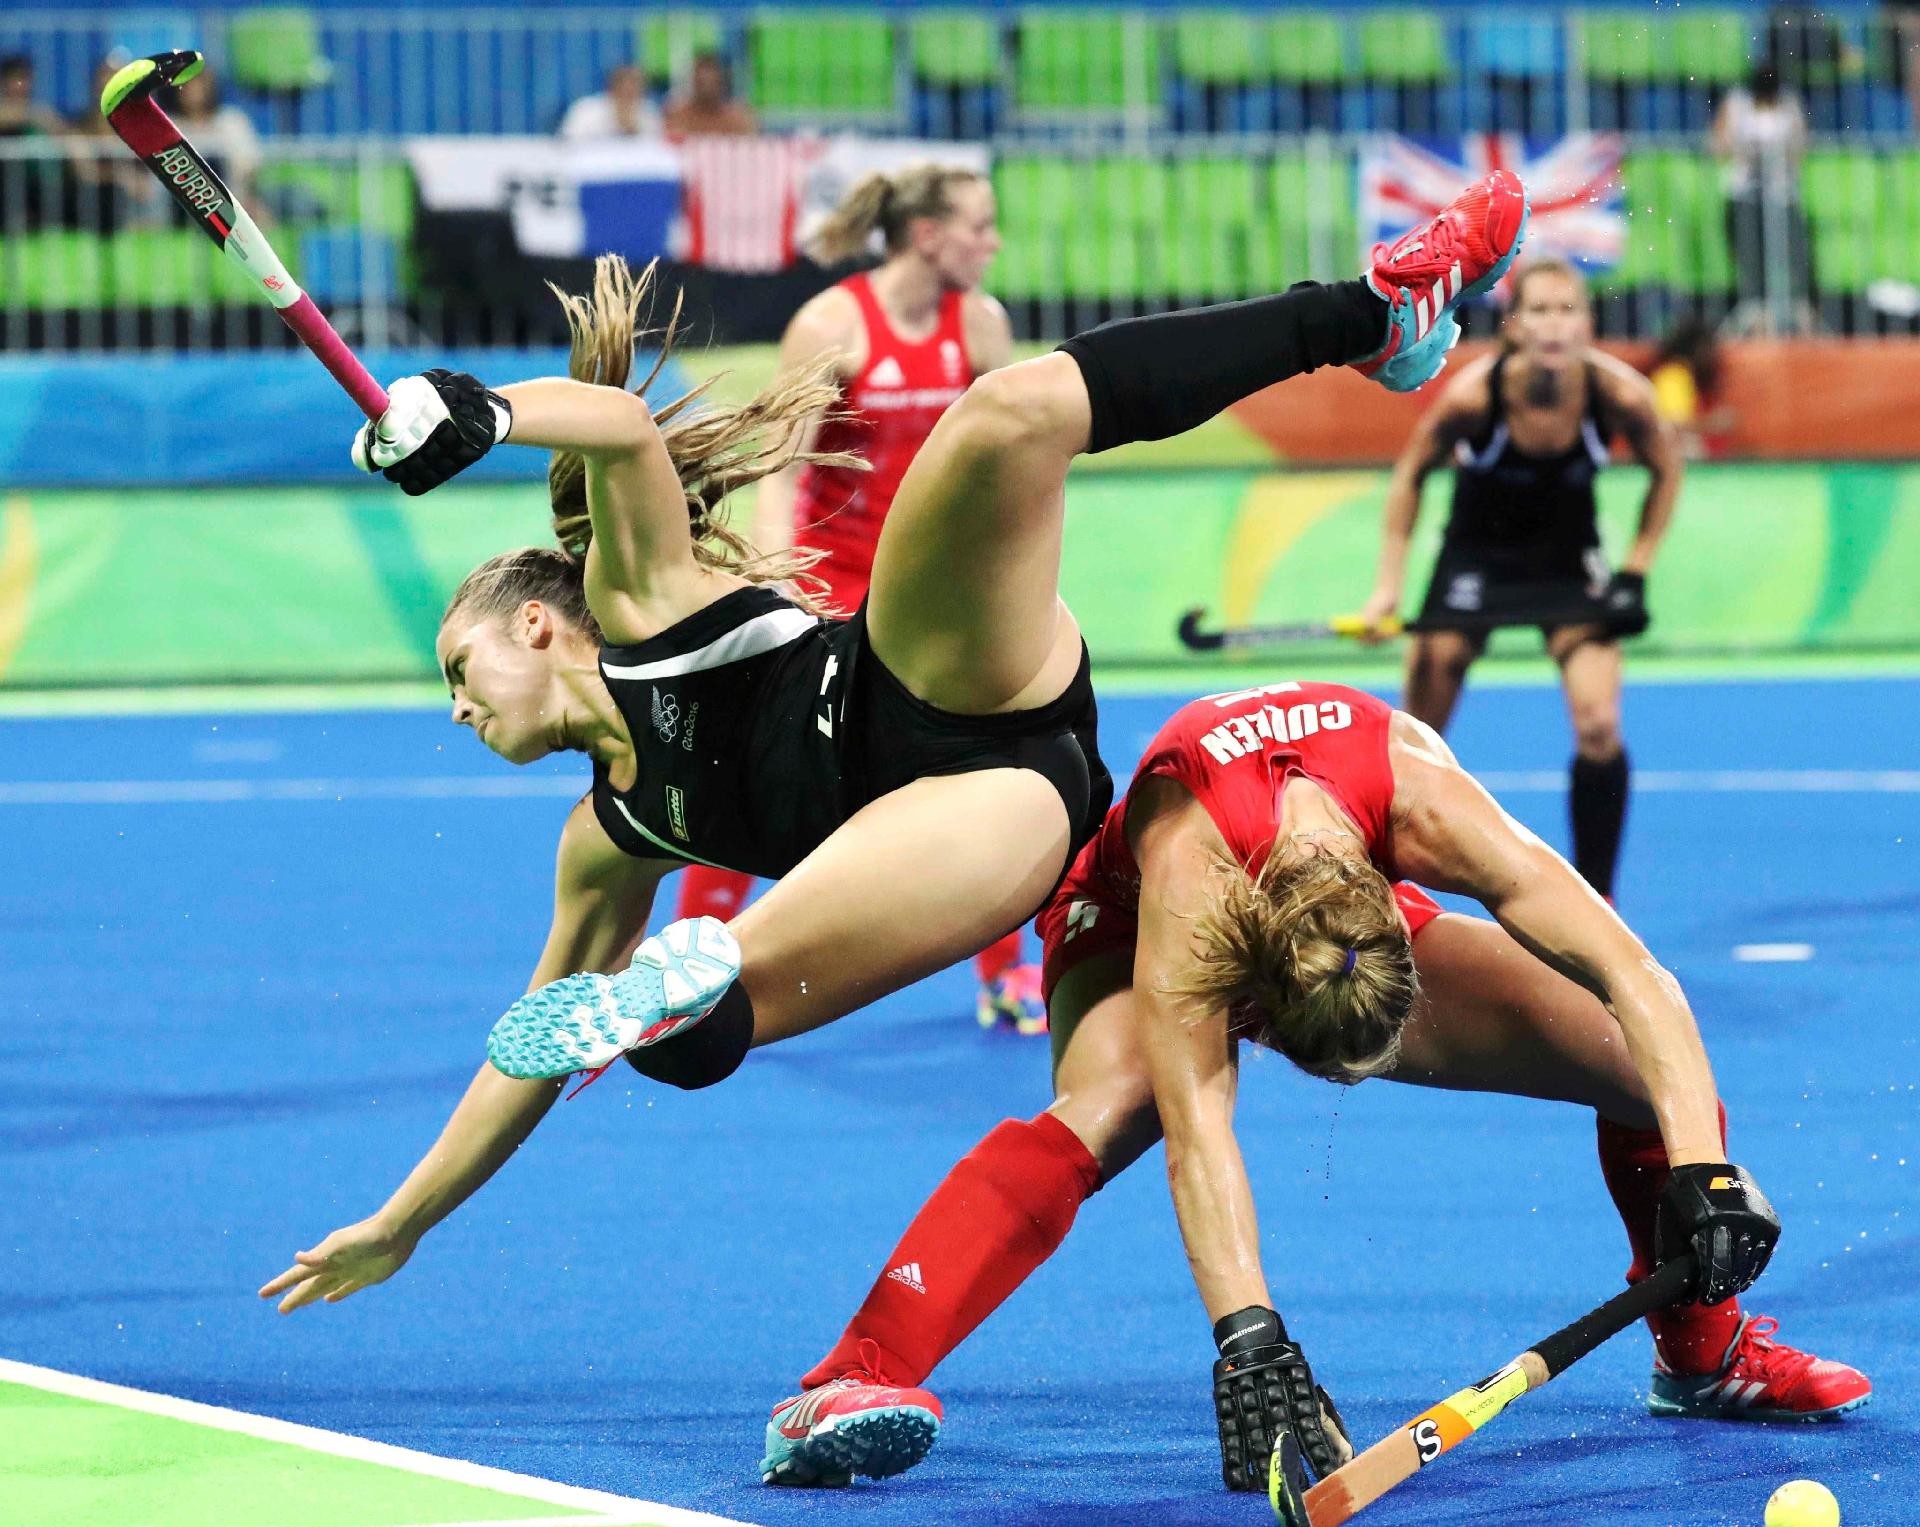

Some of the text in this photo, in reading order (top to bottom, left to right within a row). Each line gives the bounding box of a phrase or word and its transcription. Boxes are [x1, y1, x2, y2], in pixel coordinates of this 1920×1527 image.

[152, 147, 224, 219] ABURRA
[1199, 700, 1352, 766] CULLEN
[887, 1271, 927, 1295] adidas
